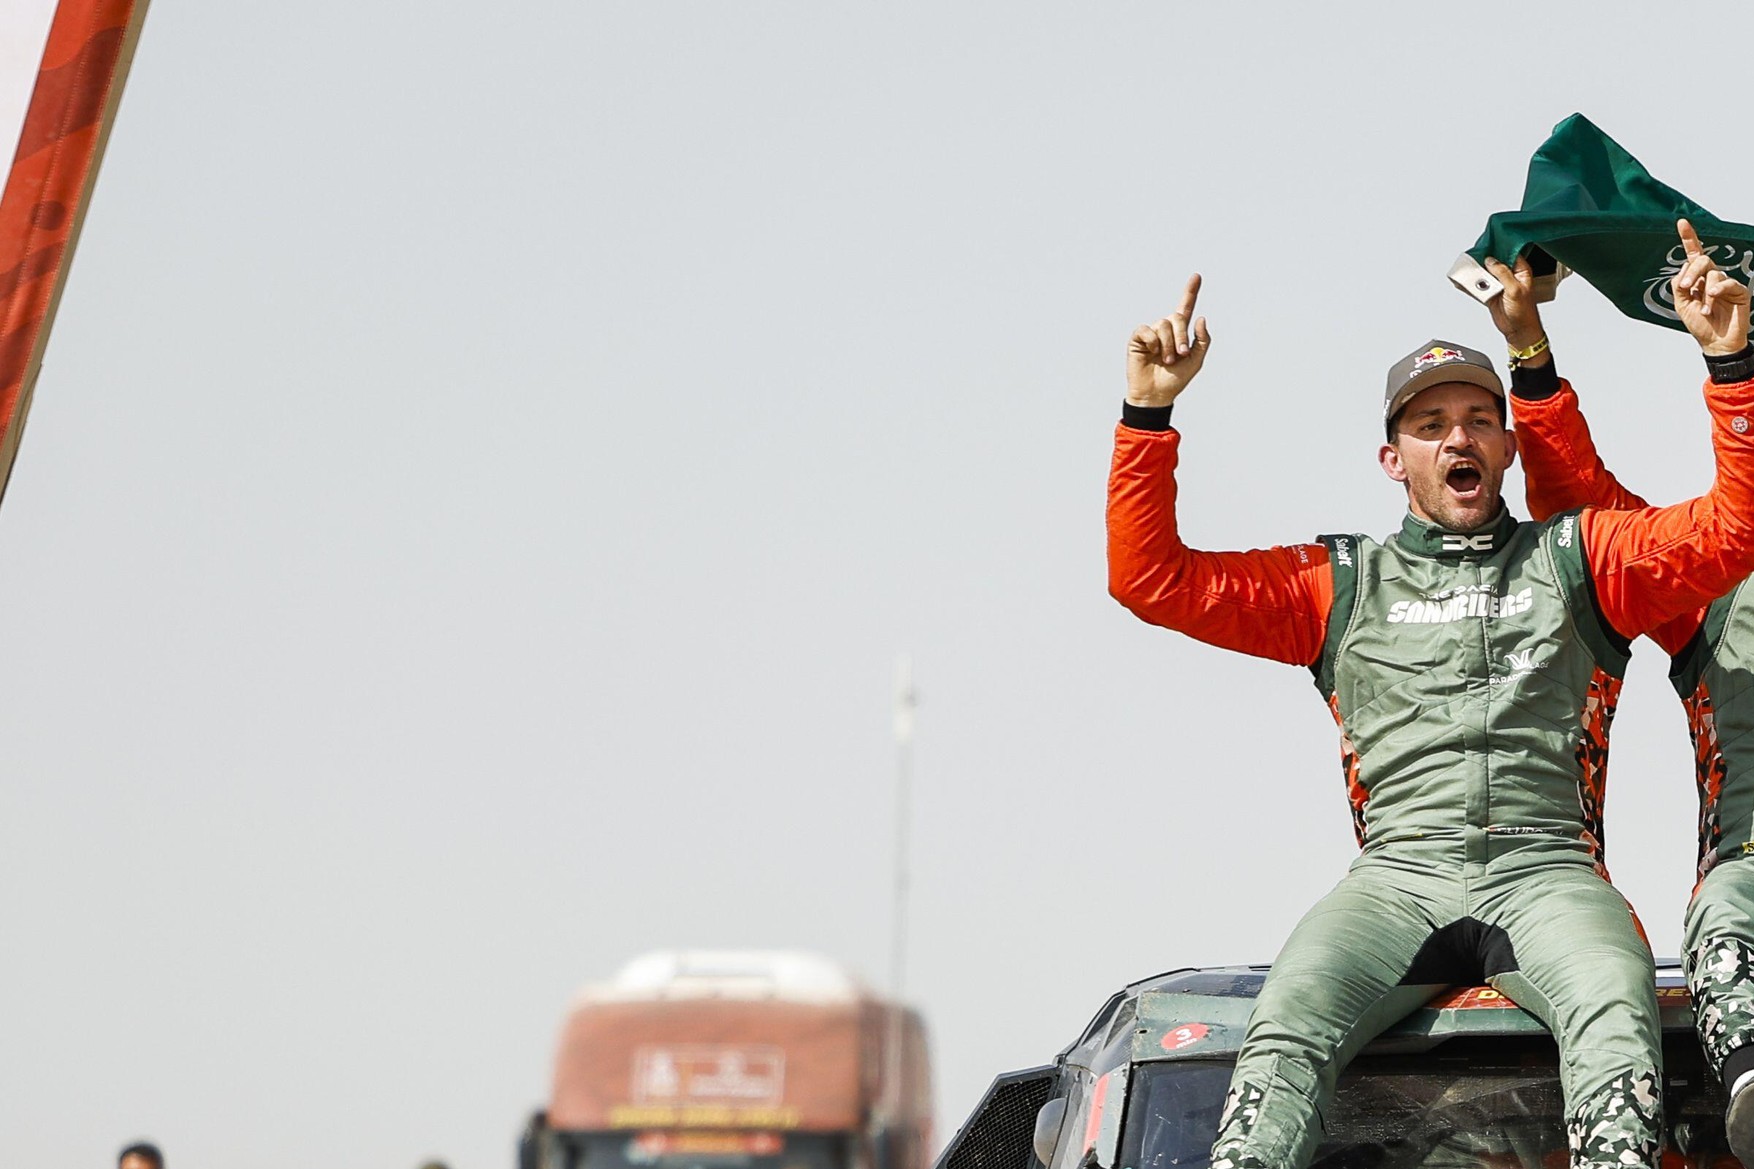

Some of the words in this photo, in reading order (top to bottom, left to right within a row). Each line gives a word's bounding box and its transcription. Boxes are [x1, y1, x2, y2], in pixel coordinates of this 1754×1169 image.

[1557, 515, 1575, 549] Sabelt
[1334, 538, 1353, 568] Sabelt
[1386, 586, 1533, 624] SANDRIDERS
[1175, 1028, 1192, 1041] 3
[1175, 1037, 1198, 1049] min
